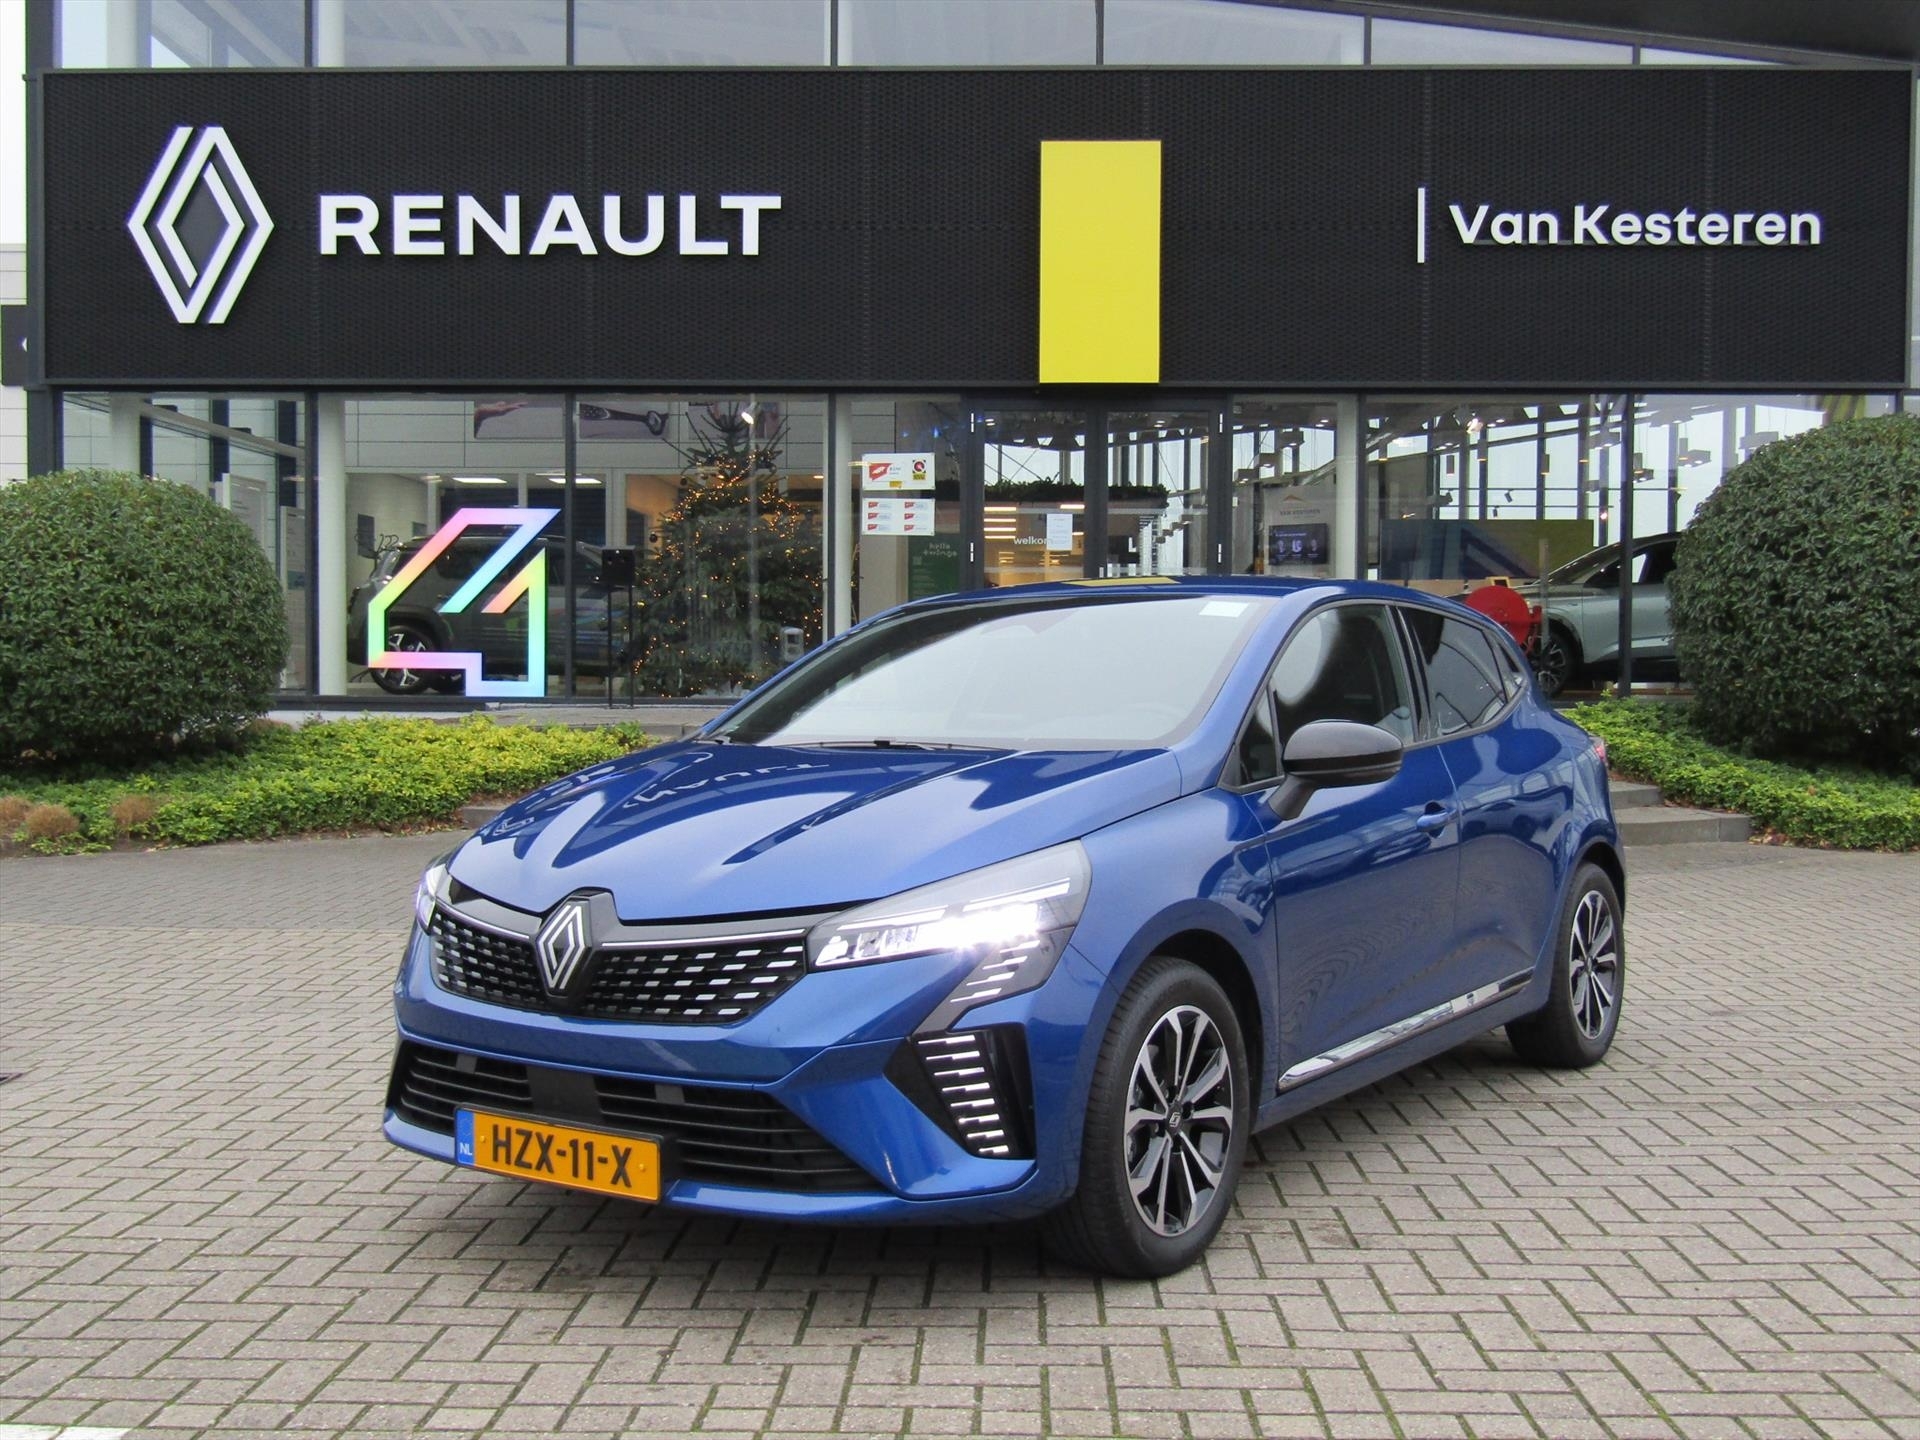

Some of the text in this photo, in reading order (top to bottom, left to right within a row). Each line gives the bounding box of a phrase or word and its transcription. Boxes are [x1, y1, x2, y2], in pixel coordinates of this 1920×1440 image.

[320, 195, 782, 256] RENAULT
[1449, 205, 1821, 245] Van Kesteren
[1013, 535, 1051, 545] welko
[459, 1123, 632, 1189] NL HZX-11-X
